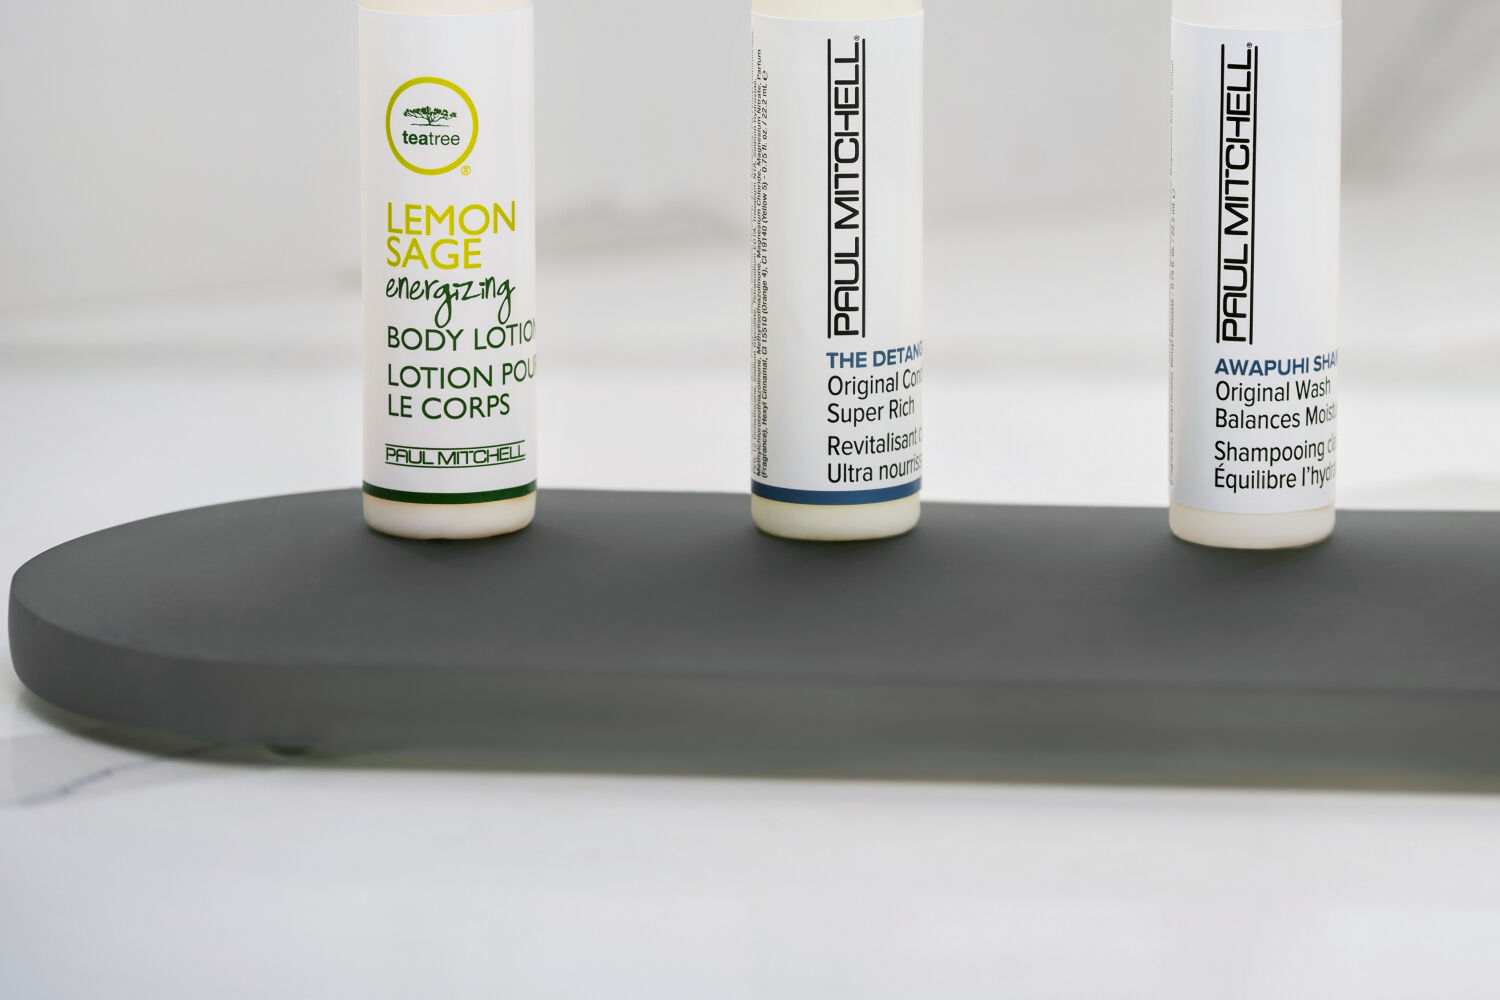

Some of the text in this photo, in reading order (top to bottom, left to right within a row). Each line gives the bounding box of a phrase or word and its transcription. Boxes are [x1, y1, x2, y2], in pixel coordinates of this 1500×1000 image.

[402, 130, 460, 145] teatree
[388, 201, 515, 236] LEMON
[386, 236, 482, 269] SAGE
[834, 237, 860, 336] PAUL
[1221, 243, 1248, 342] PAUL
[385, 276, 515, 328] energizing
[388, 326, 464, 351] BODY
[388, 355, 536, 389] LOTION POU
[826, 352, 867, 368] THE
[1215, 350, 1338, 376] AWAPUHI SHA
[828, 368, 922, 400] Original Con
[1216, 376, 1330, 406] Original Wash
[388, 393, 510, 419] LE CORPS
[827, 396, 914, 427] Super Rich
[1216, 401, 1336, 429] Balances Moist
[386, 445, 525, 465] PAUL MITCHELL
[828, 426, 917, 455] Revitalisant
[1214, 440, 1324, 466] Shampooing
[828, 463, 873, 483] Ultra
[1215, 463, 1296, 493] Équilibre
